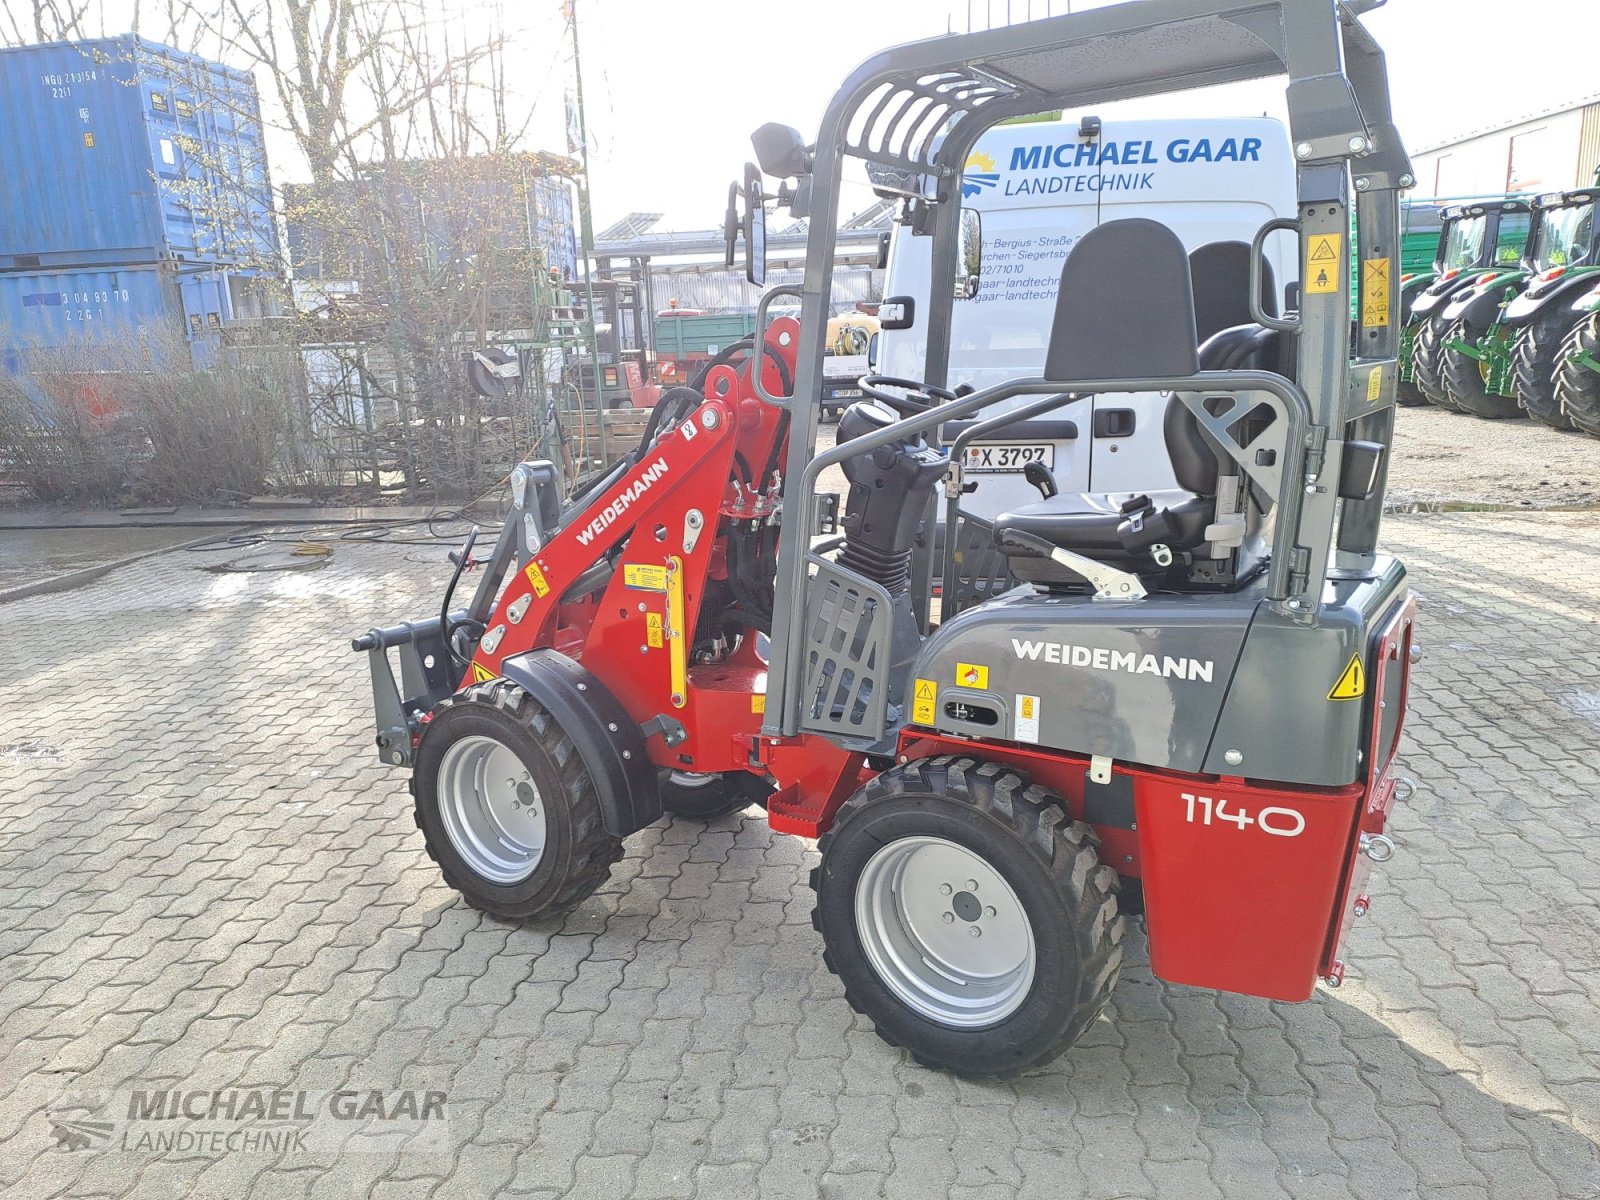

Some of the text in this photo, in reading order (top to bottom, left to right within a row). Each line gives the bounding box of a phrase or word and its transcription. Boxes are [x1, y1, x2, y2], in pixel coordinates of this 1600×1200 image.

[1009, 137, 1262, 171] MICHAEL GAAR
[1003, 171, 1156, 197] LANDTECHNIK
[982, 448, 992, 466] X
[997, 447, 1046, 466] 3797
[575, 457, 670, 546] WEIDEMANN
[1011, 638, 1214, 683] WEIDEMANN
[1180, 793, 1306, 837] 1140
